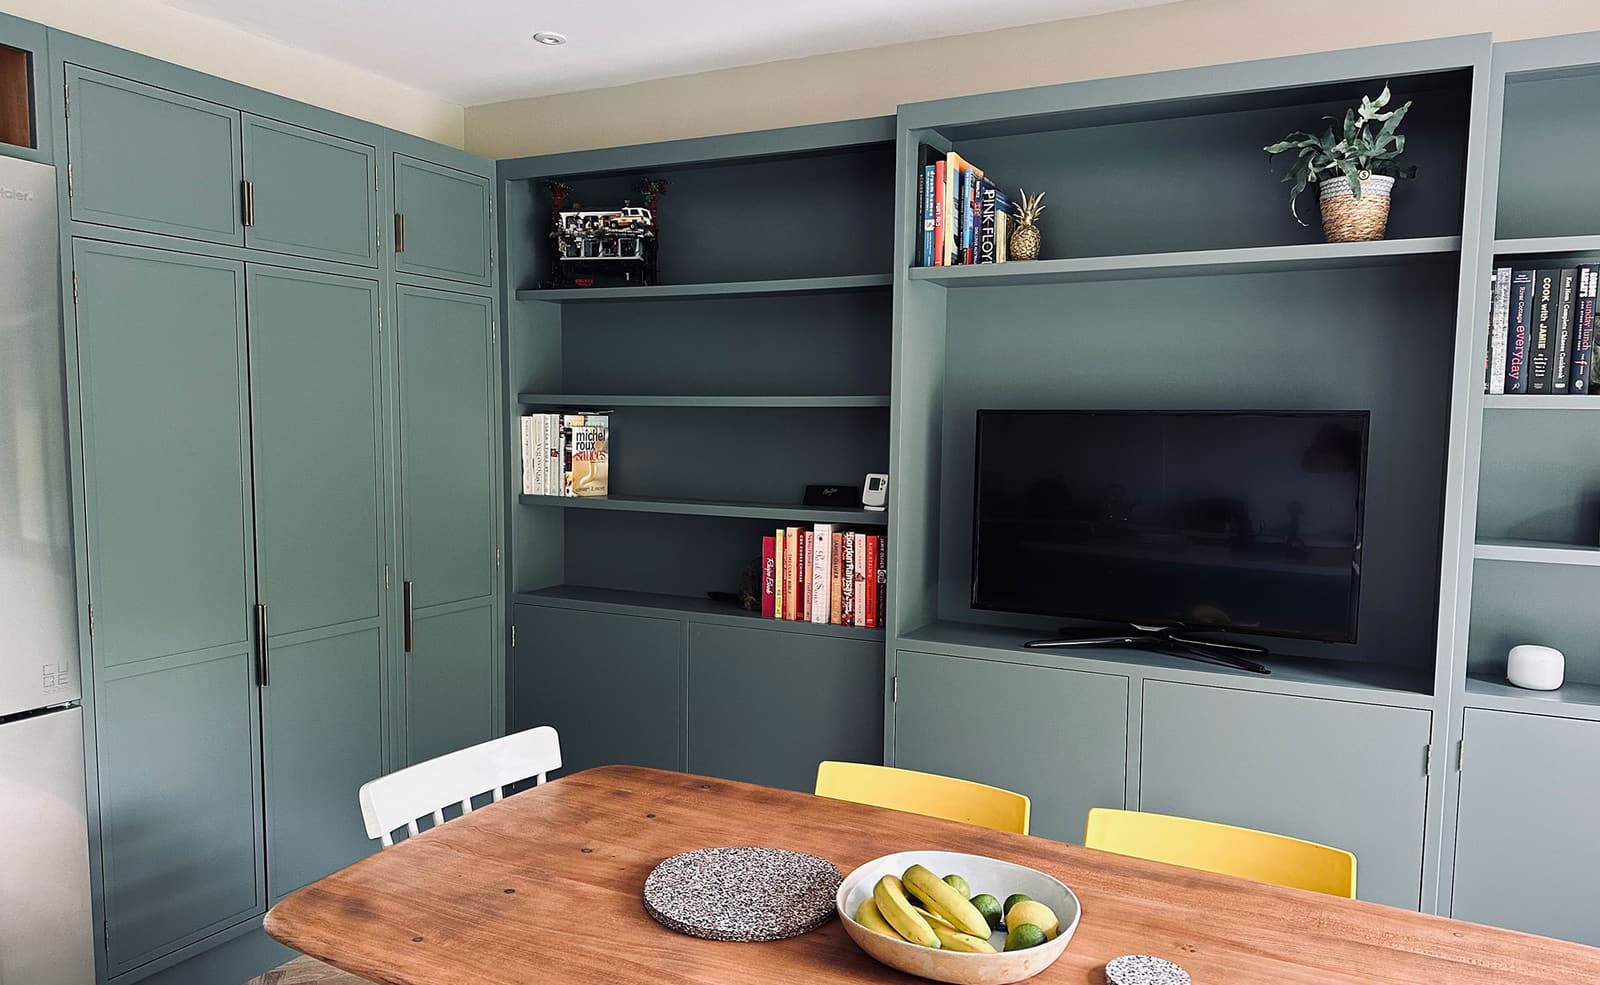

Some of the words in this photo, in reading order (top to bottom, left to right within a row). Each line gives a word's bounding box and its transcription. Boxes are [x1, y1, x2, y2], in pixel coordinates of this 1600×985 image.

[982, 189, 995, 224] PINK
[1541, 277, 1551, 302] COOK
[1540, 303, 1549, 322] with
[1583, 300, 1594, 328] sunday
[1538, 323, 1547, 349] JAMIE
[1582, 329, 1592, 350] lunch
[1509, 325, 1525, 380] everyday
[575, 428, 606, 442] michel
[575, 441, 596, 451] roux
[843, 563, 854, 597] Ramsay
